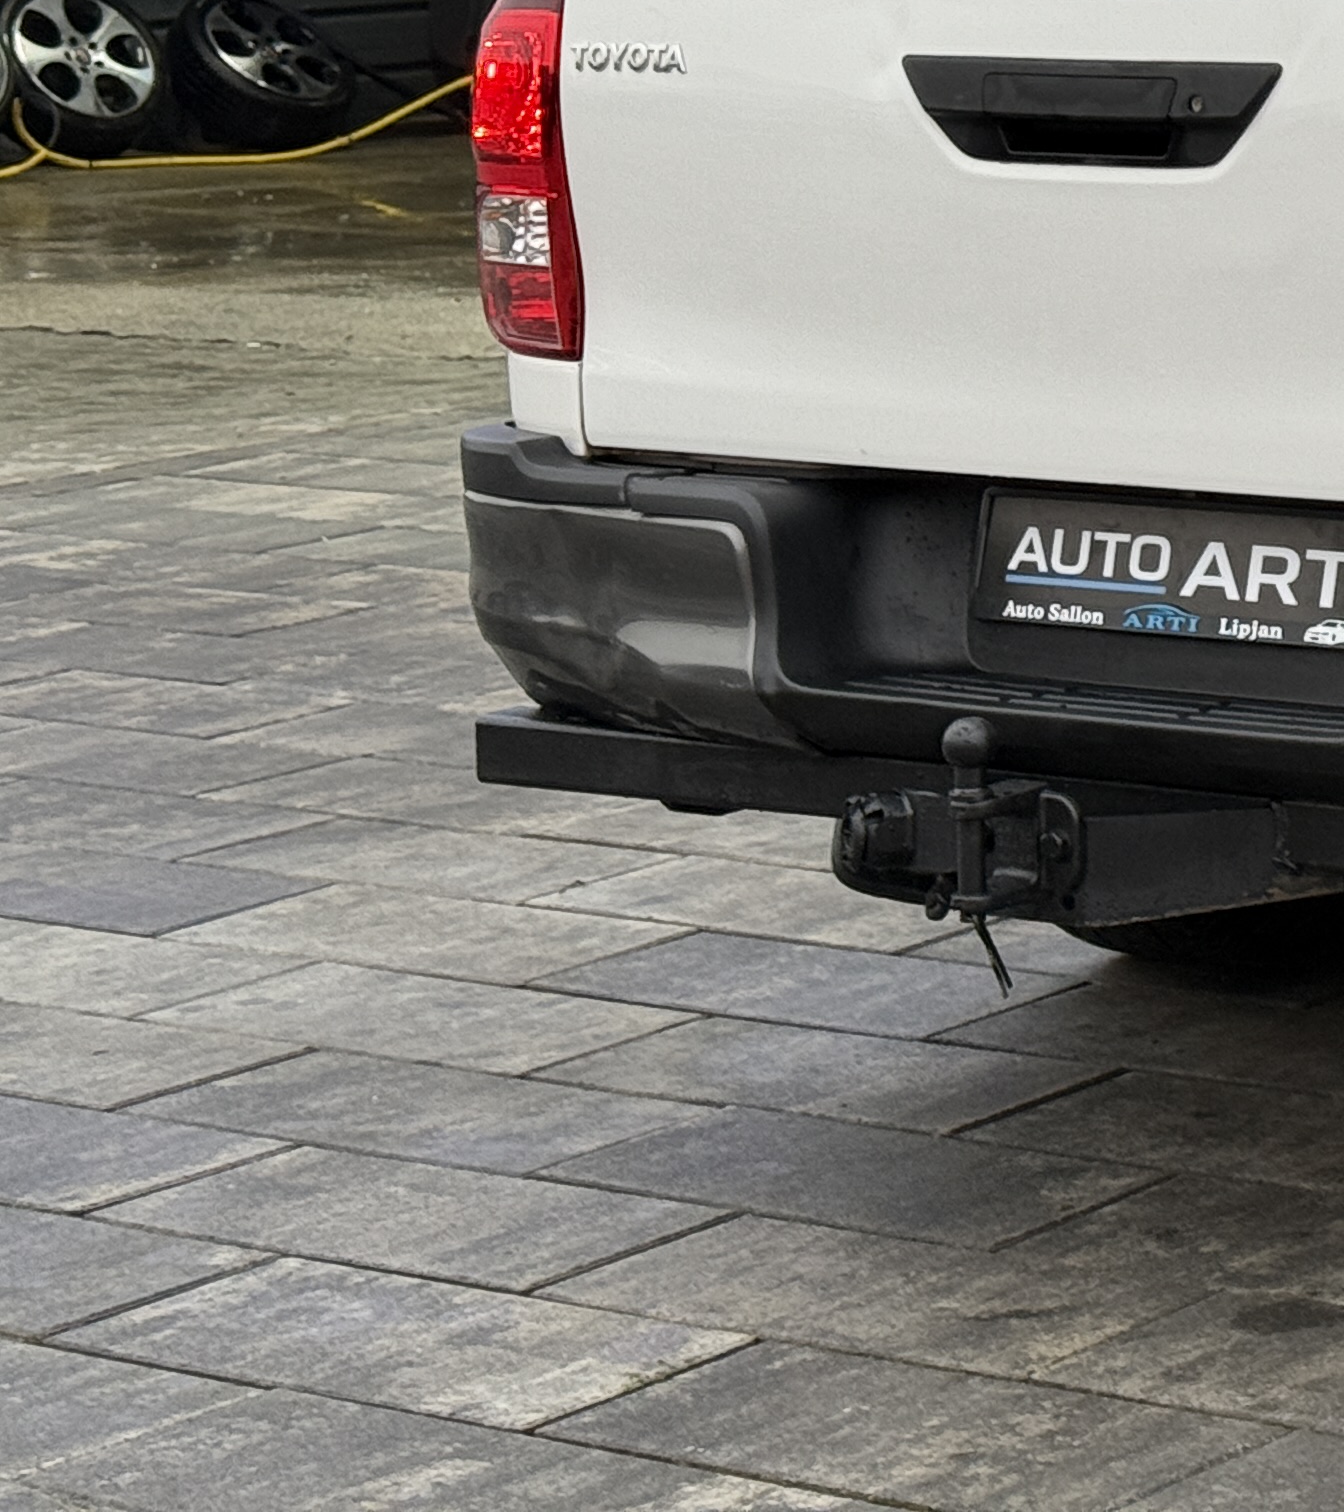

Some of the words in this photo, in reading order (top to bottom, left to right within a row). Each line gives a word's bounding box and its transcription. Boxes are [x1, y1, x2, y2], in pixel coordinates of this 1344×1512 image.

[569, 40, 687, 75] TOYOTA
[1006, 525, 1172, 583] AUTO
[1001, 599, 1045, 621] Auto
[1047, 602, 1104, 627] Sallon
[1121, 612, 1201, 633] ARTI
[1218, 617, 1284, 641] Lipjan
